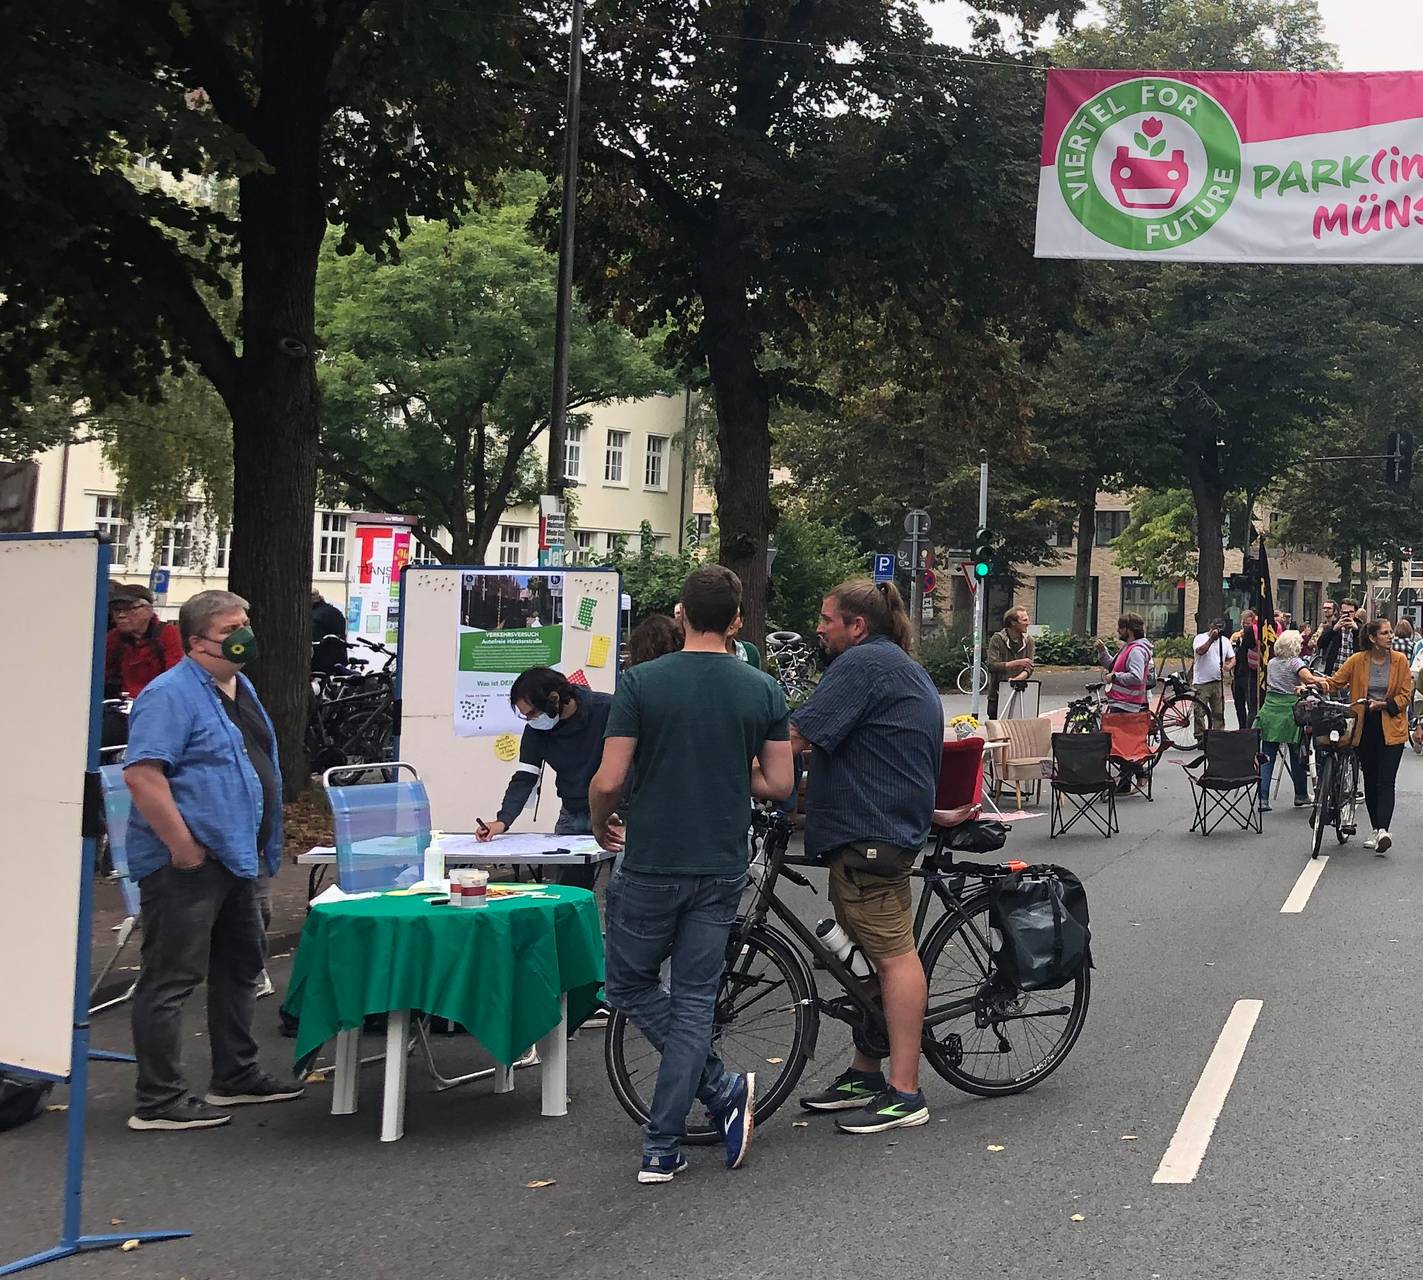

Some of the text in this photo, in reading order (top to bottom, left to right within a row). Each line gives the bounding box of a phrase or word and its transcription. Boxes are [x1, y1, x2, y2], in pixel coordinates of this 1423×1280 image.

[1063, 85, 1200, 200] VIERTEL FOR
[1144, 167, 1234, 245] FUTURE
[879, 557, 889, 571] P
